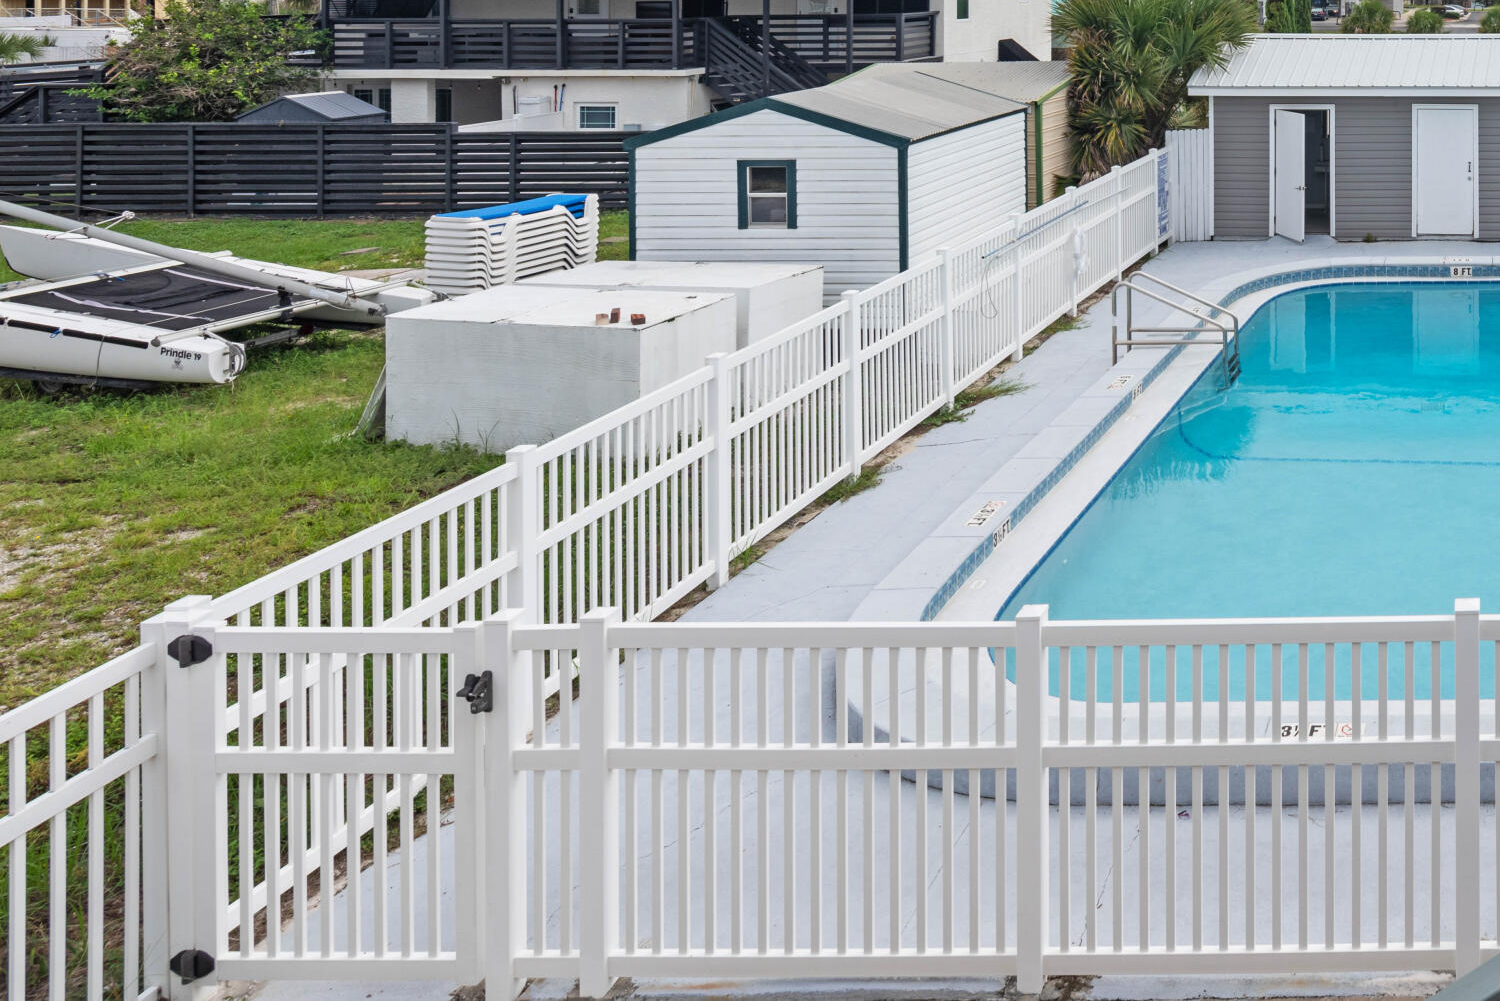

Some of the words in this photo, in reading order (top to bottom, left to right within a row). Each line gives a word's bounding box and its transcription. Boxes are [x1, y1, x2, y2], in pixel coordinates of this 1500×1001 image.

[1453, 268, 1459, 276] 8
[160, 347, 192, 360] Prindle
[194, 353, 202, 361] 19
